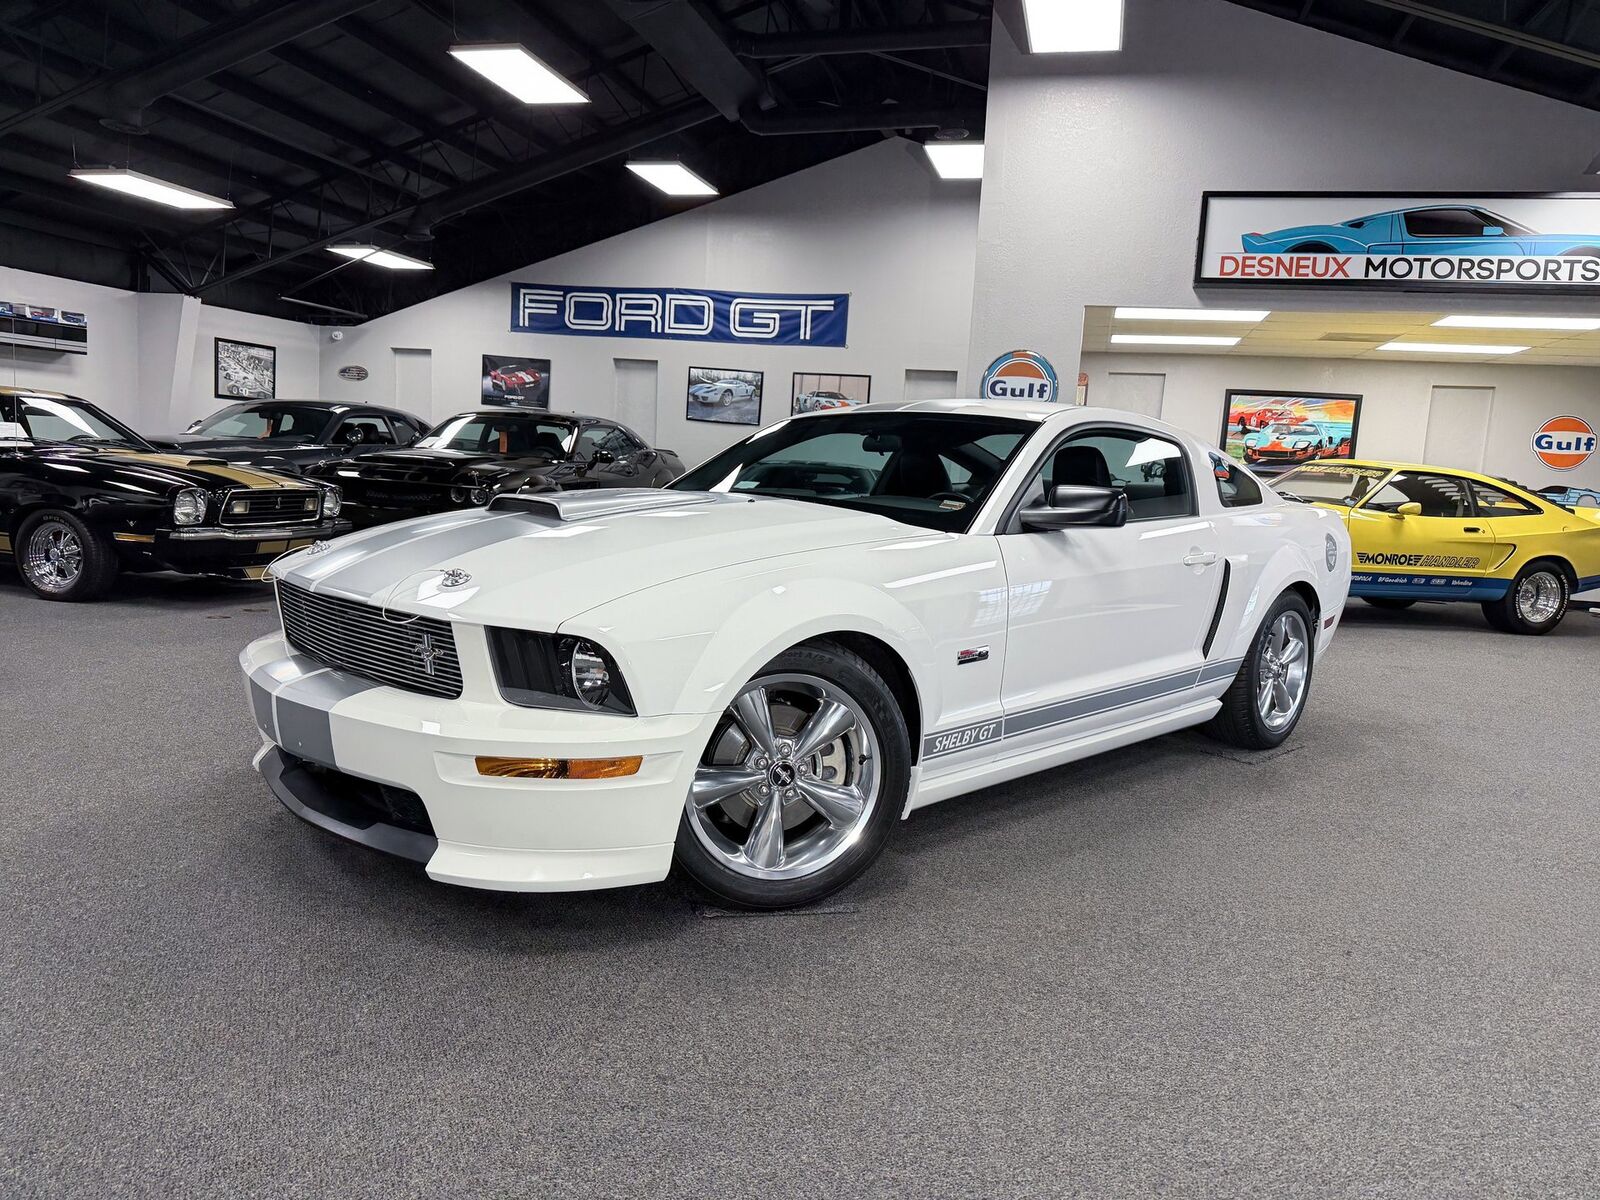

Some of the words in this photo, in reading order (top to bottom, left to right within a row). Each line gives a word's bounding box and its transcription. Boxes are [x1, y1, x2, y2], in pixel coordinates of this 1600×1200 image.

[1219, 255, 1352, 278] DESNEUX
[1364, 257, 1600, 281] MOTORSPORTS
[519, 288, 713, 335] FORD
[729, 298, 834, 340] GT
[990, 380, 1048, 398] Gulf
[1535, 434, 1595, 451] Gulf
[1364, 553, 1415, 566] MONROE
[1420, 555, 1480, 568] HANDLER
[1378, 576, 1408, 584] BFGoodrich
[933, 727, 980, 753] SHELBY
[979, 723, 997, 740] GT
